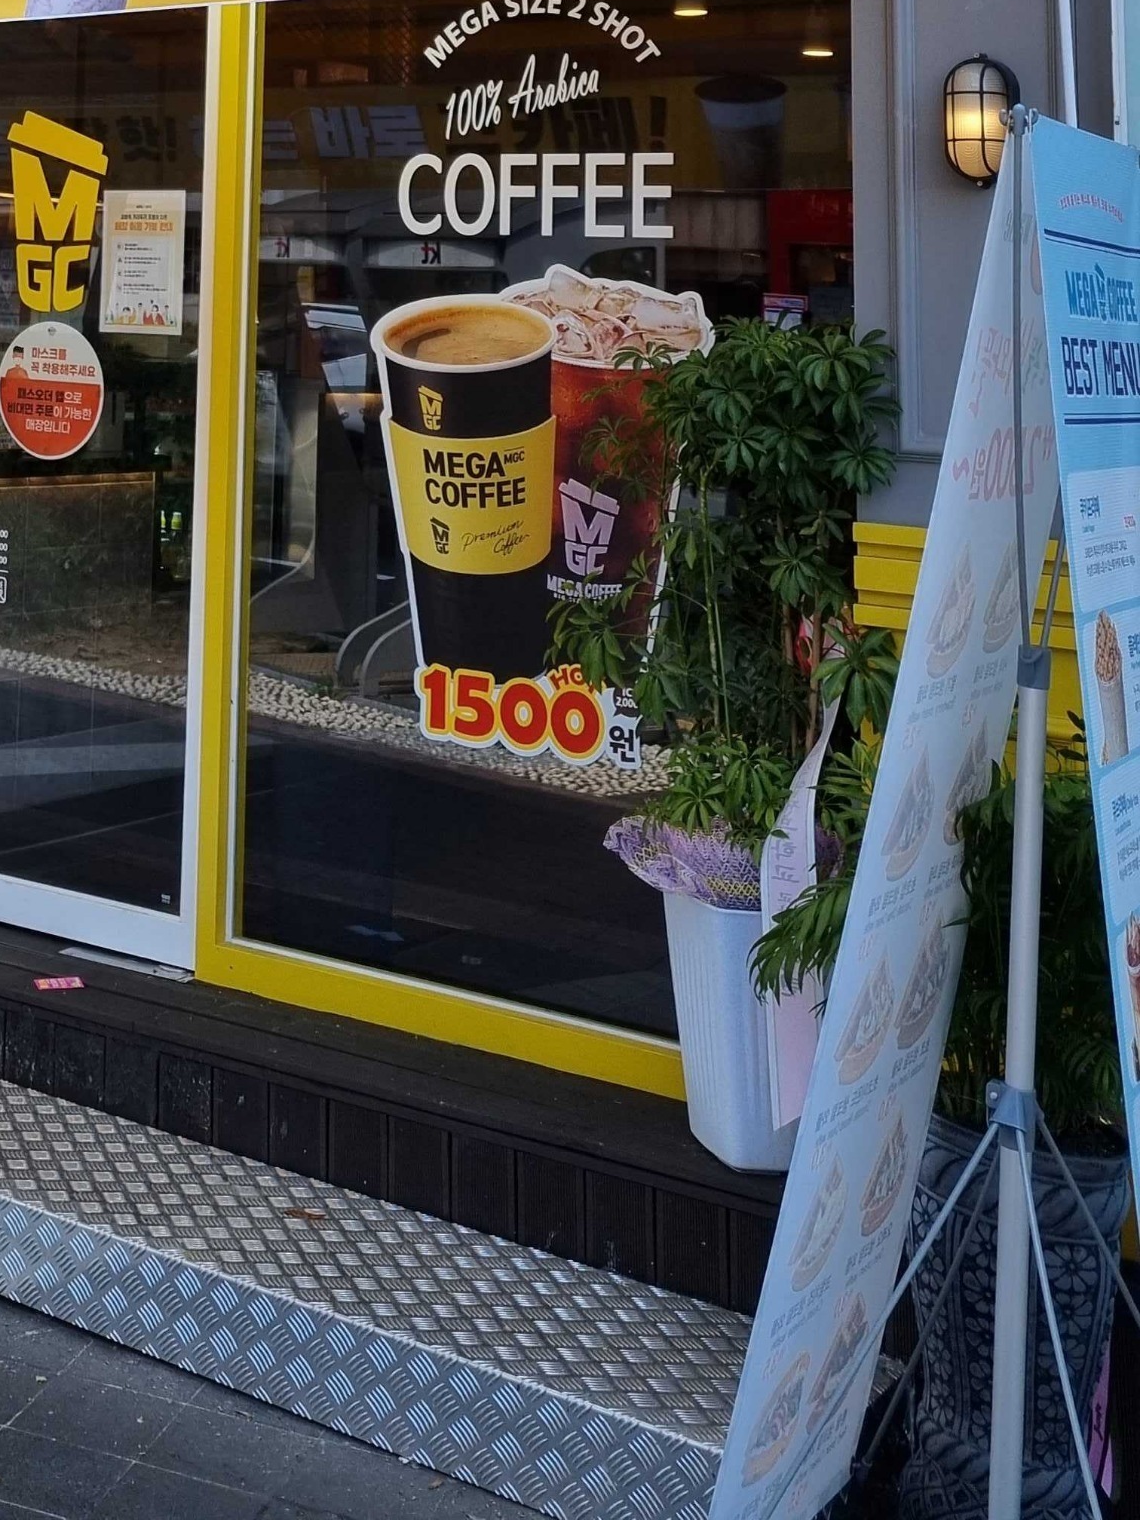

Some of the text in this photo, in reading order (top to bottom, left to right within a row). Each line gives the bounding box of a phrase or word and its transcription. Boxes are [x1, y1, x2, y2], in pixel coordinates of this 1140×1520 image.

[423, 1, 501, 69] MEGA
[587, 1, 662, 64] SHOT
[445, 52, 600, 141] 100% Arabica
[398, 152, 675, 239] COFFEE
[1064, 270, 1138, 323] MEGA COFFEE
[31, 362, 96, 377] 꼭 착용해주세요
[32, 347, 67, 361] 마스크를
[1061, 337, 1099, 396] BEST
[7, 401, 92, 421] 비대면 주문이 가능한
[25, 418, 71, 434] 매장입니다
[423, 448, 526, 479] MEGA MGC
[424, 477, 527, 509] COFFEE
[461, 518, 525, 553] Premium
[492, 532, 531, 556] Coffee
[423, 668, 601, 755] 1500
